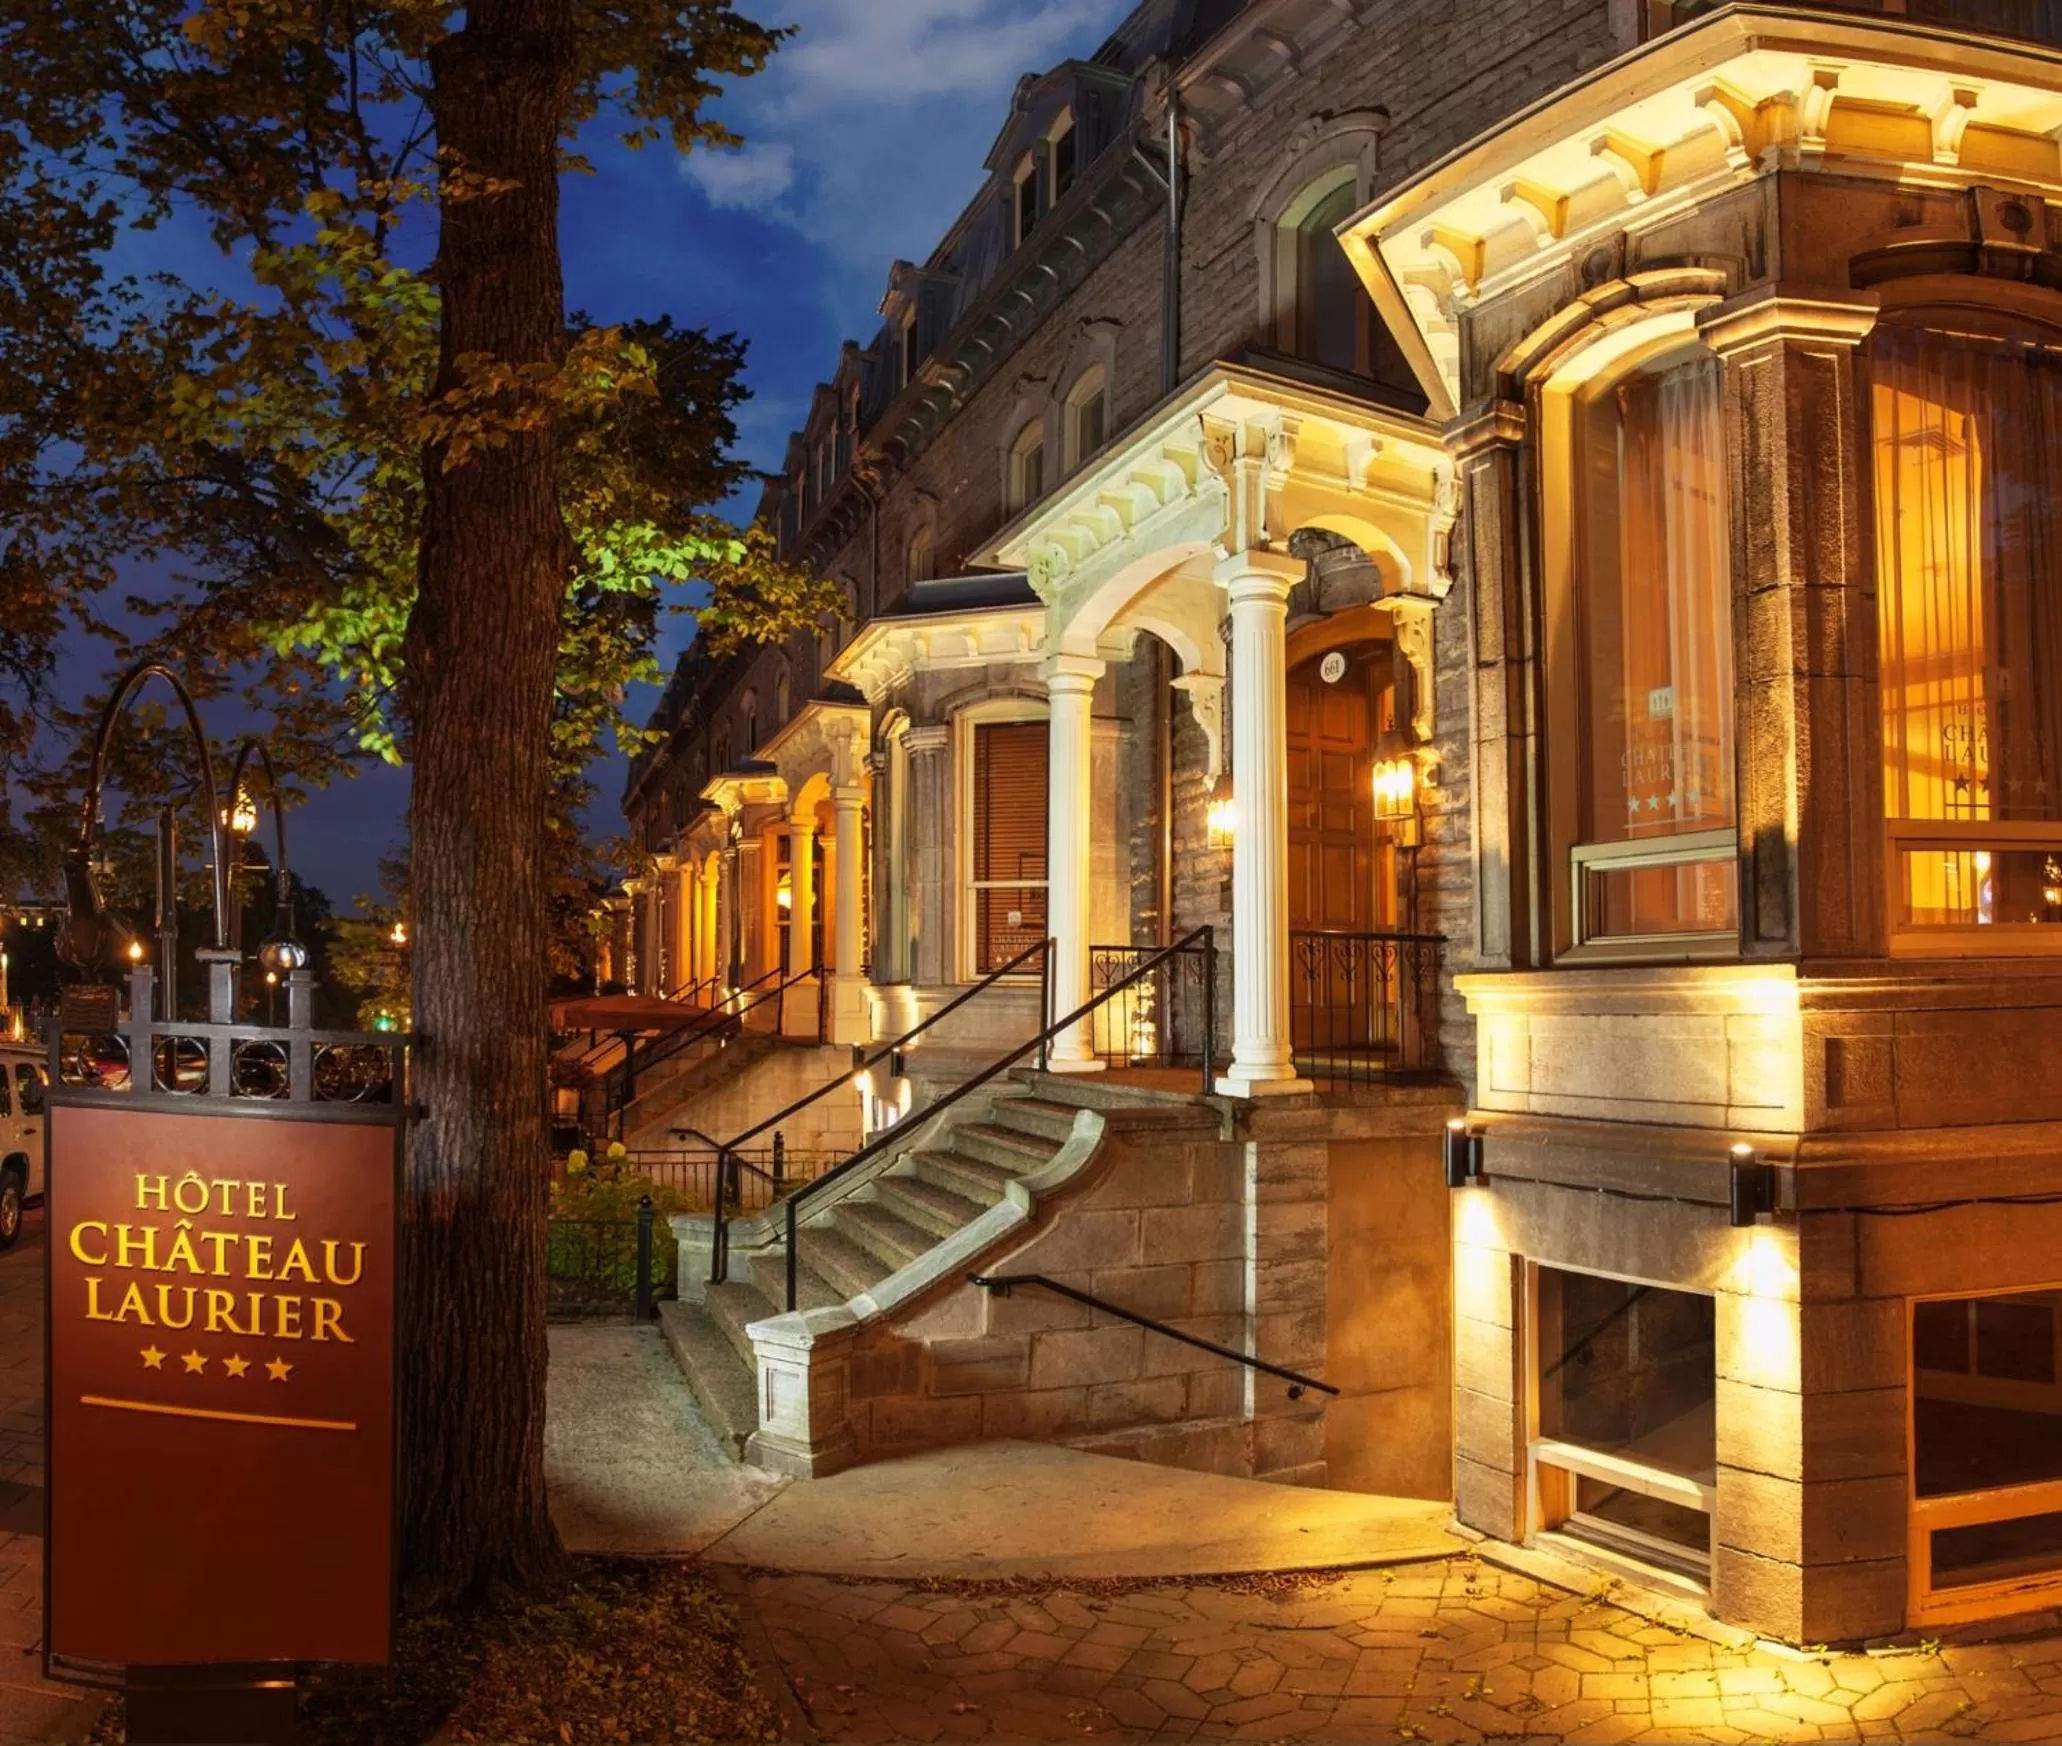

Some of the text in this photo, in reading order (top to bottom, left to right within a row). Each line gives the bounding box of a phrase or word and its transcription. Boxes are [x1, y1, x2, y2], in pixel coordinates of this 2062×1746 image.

[134, 1169, 297, 1220] HÔTEL
[69, 1217, 368, 1286] CHÂTEAU
[84, 1277, 355, 1343] LAURIER
